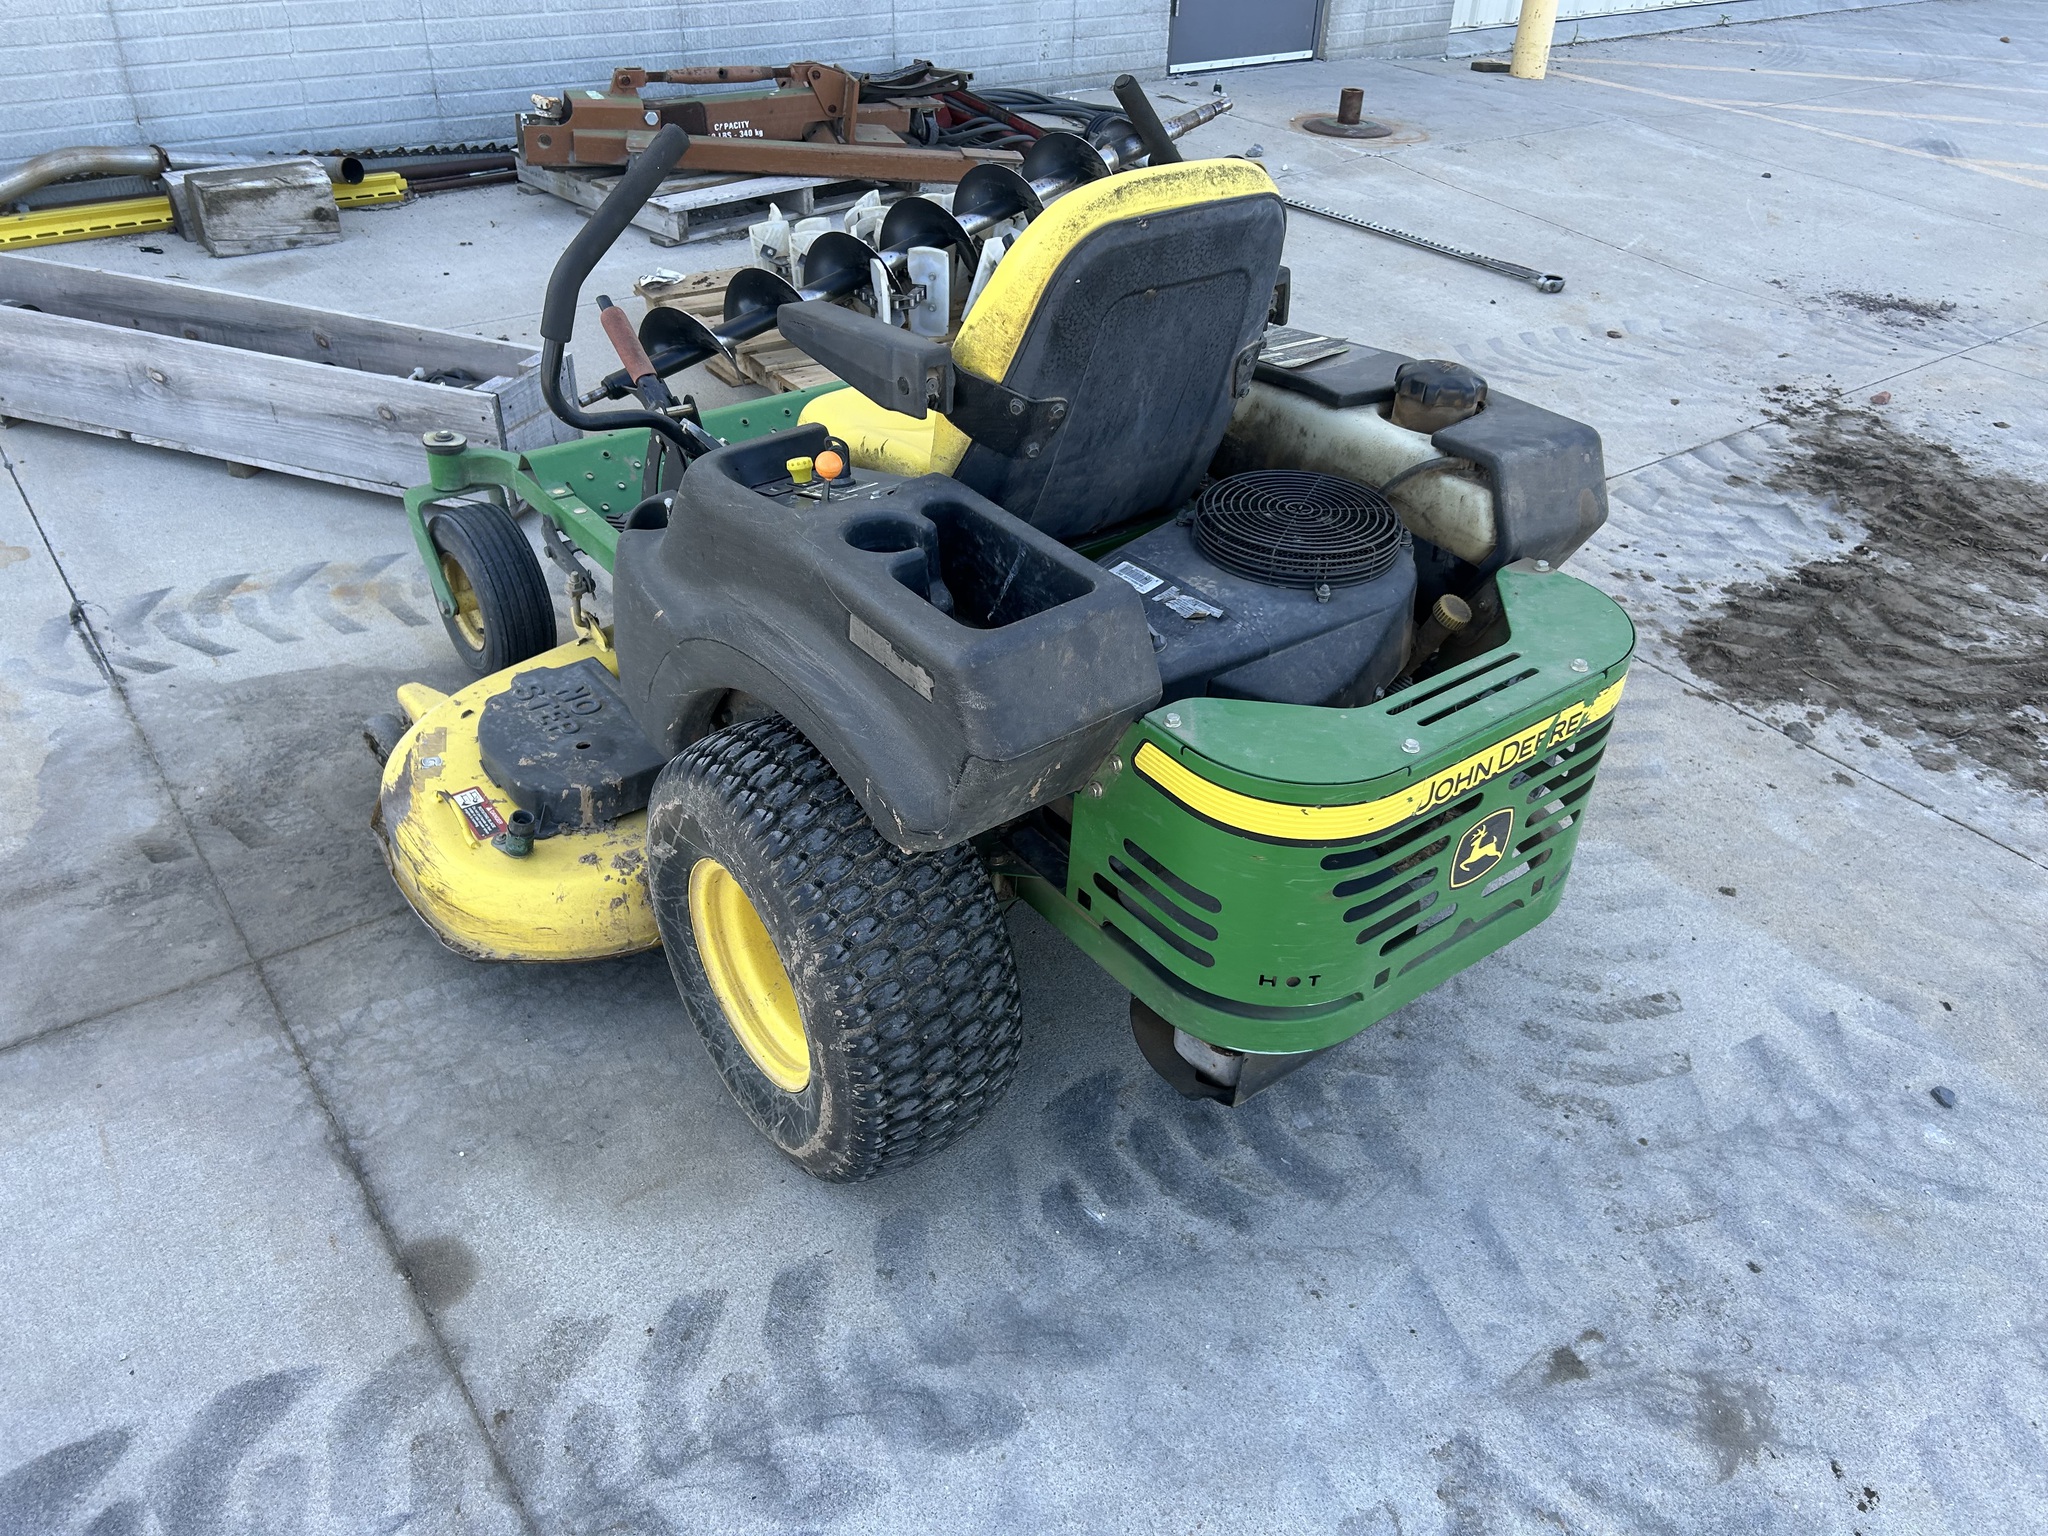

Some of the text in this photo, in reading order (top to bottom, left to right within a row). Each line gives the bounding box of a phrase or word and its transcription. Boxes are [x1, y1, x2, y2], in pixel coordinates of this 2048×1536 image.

[739, 129, 753, 138] 340
[754, 128, 764, 138] kg
[514, 685, 581, 735] STEP
[555, 685, 603, 716] NO
[1418, 756, 1494, 810] JOHN
[1258, 974, 1322, 987] HOT
